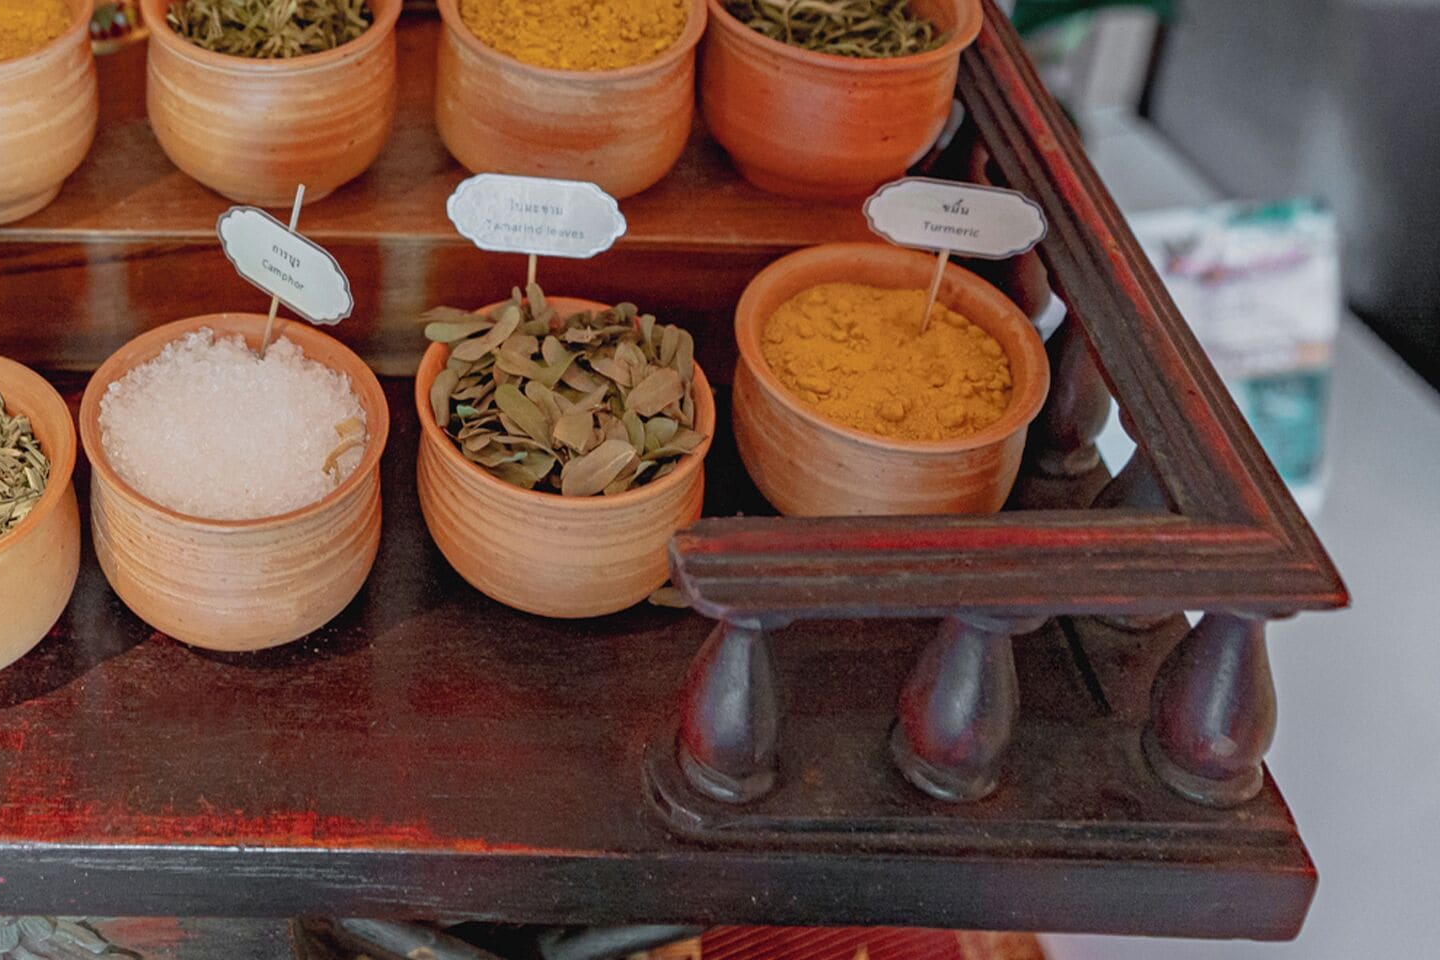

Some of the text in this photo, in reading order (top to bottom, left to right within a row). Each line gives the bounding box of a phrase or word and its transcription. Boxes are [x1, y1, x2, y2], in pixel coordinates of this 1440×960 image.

[485, 218, 585, 240] Tamarind leaves
[923, 220, 980, 238] Turmeric
[271, 243, 301, 269] การบูร
[261, 258, 305, 290] Camphor
